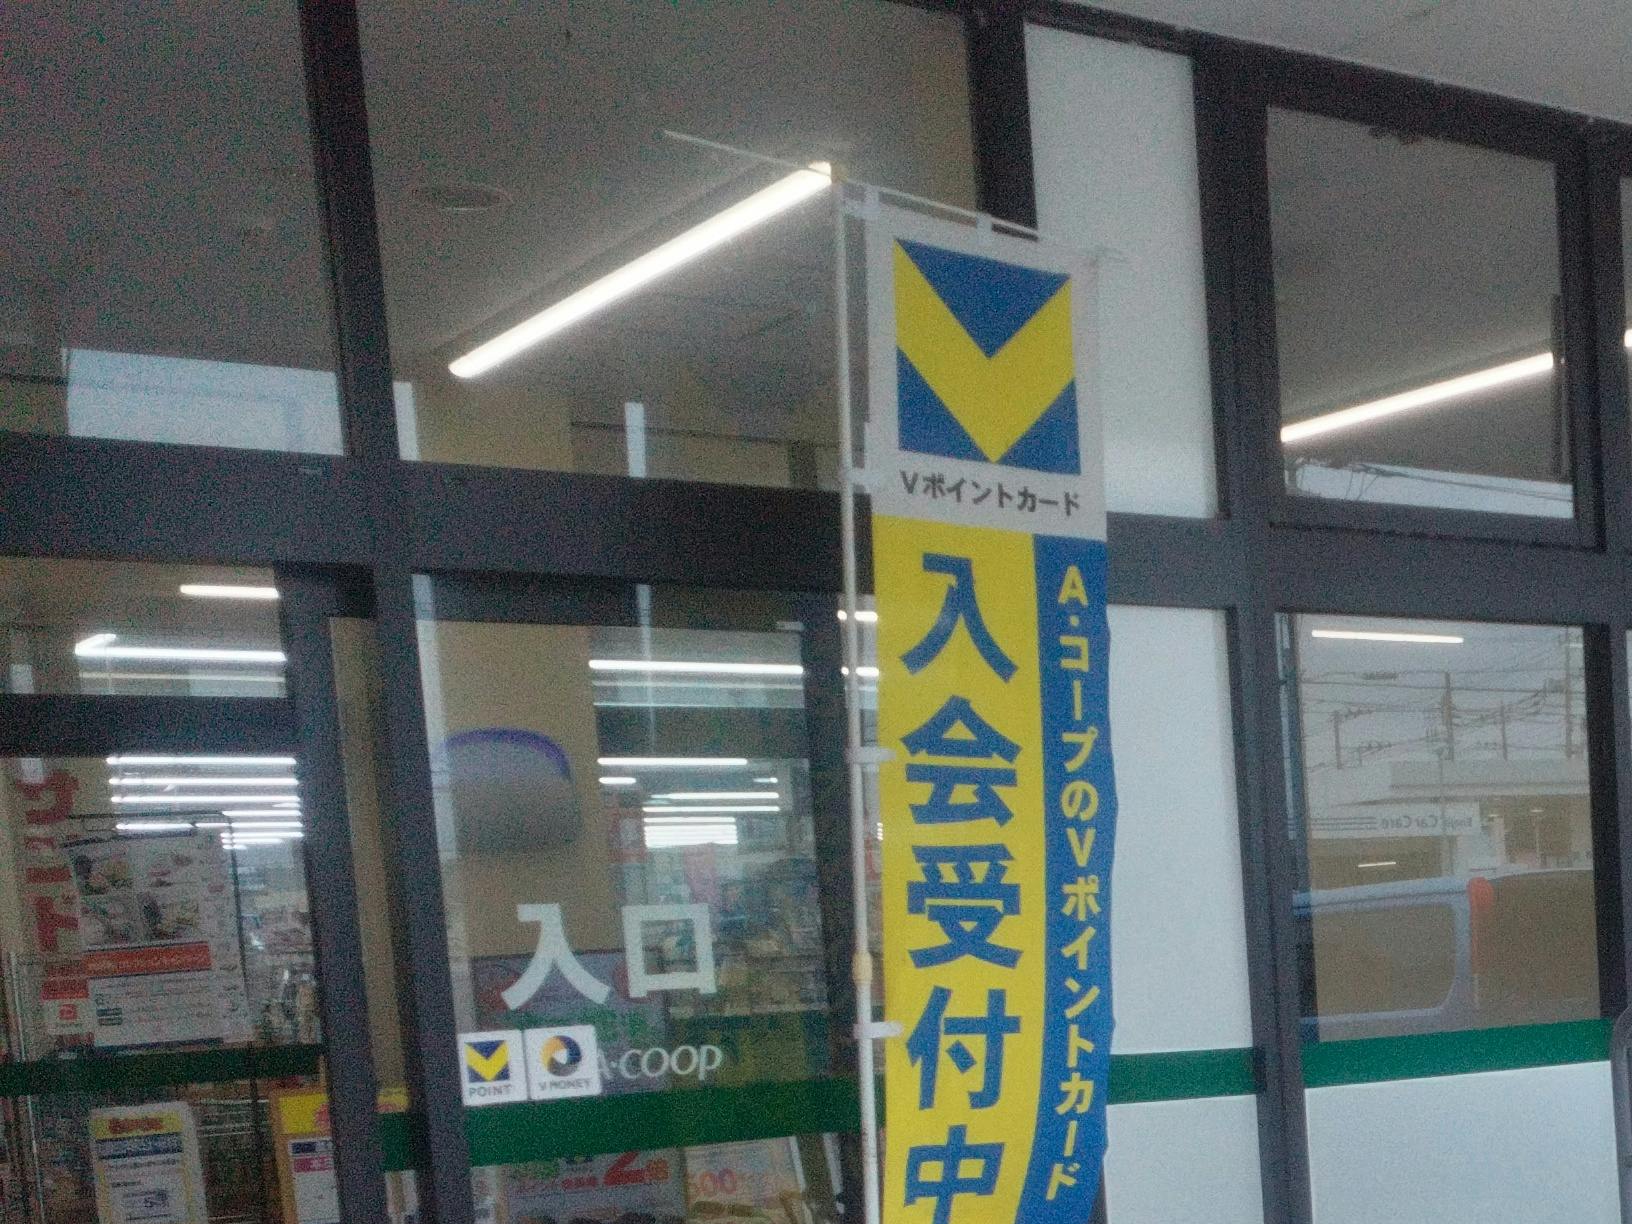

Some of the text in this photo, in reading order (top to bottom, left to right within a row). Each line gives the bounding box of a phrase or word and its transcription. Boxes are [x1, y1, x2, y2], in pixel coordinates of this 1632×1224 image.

[902, 471, 1080, 517] Vポイントカード
[1045, 565, 1101, 1201] A・コープのVポイントカード
[500, 902, 717, 1011] 入口
[468, 1083, 512, 1098] POINT
[549, 1078, 591, 1091] MONEY
